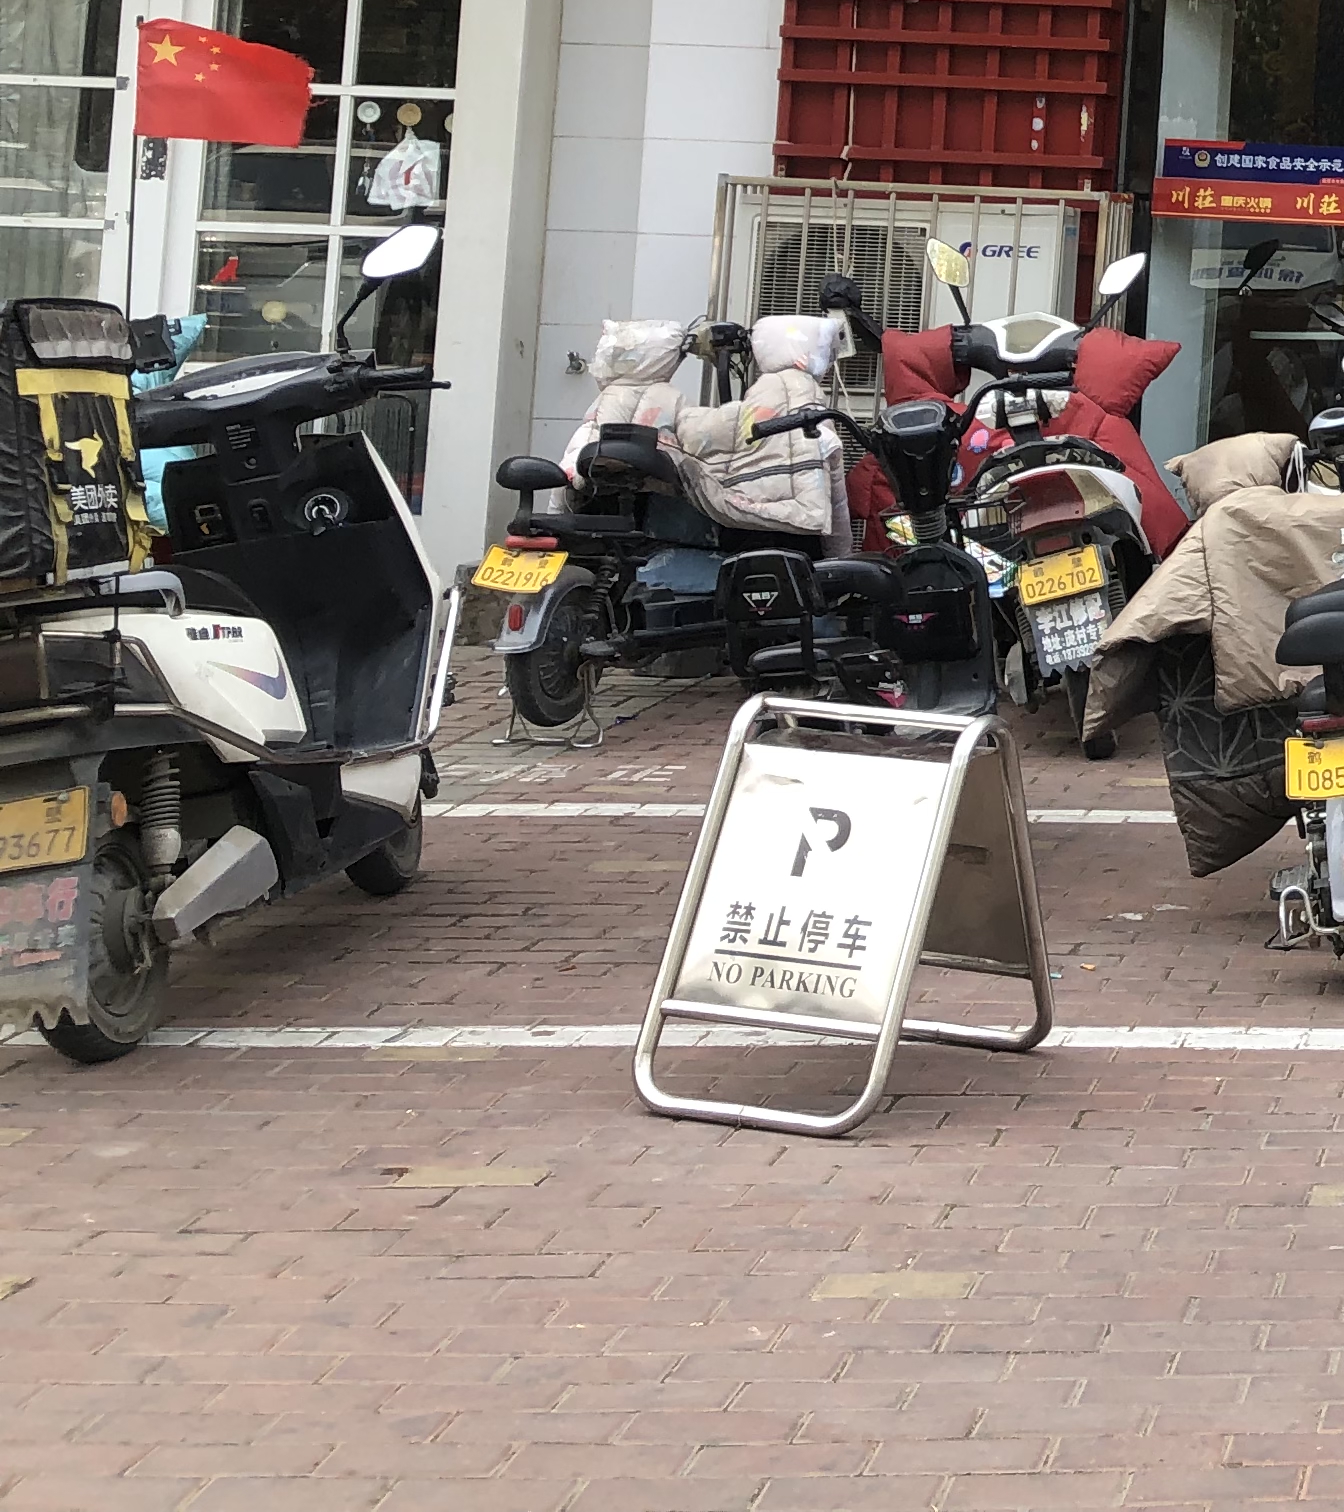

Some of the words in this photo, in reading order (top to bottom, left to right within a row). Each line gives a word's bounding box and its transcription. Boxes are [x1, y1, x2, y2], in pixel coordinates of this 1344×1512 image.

[1221, 196, 1272, 210] 重庆火锅
[981, 245, 1041, 259] GREE
[70, 484, 118, 510] 美团外卖
[481, 566, 551, 587] 0221916
[1026, 567, 1098, 599] 0226702
[719, 900, 873, 958] 禁止停车
[706, 960, 742, 985] NO
[750, 963, 858, 999] PARKING
